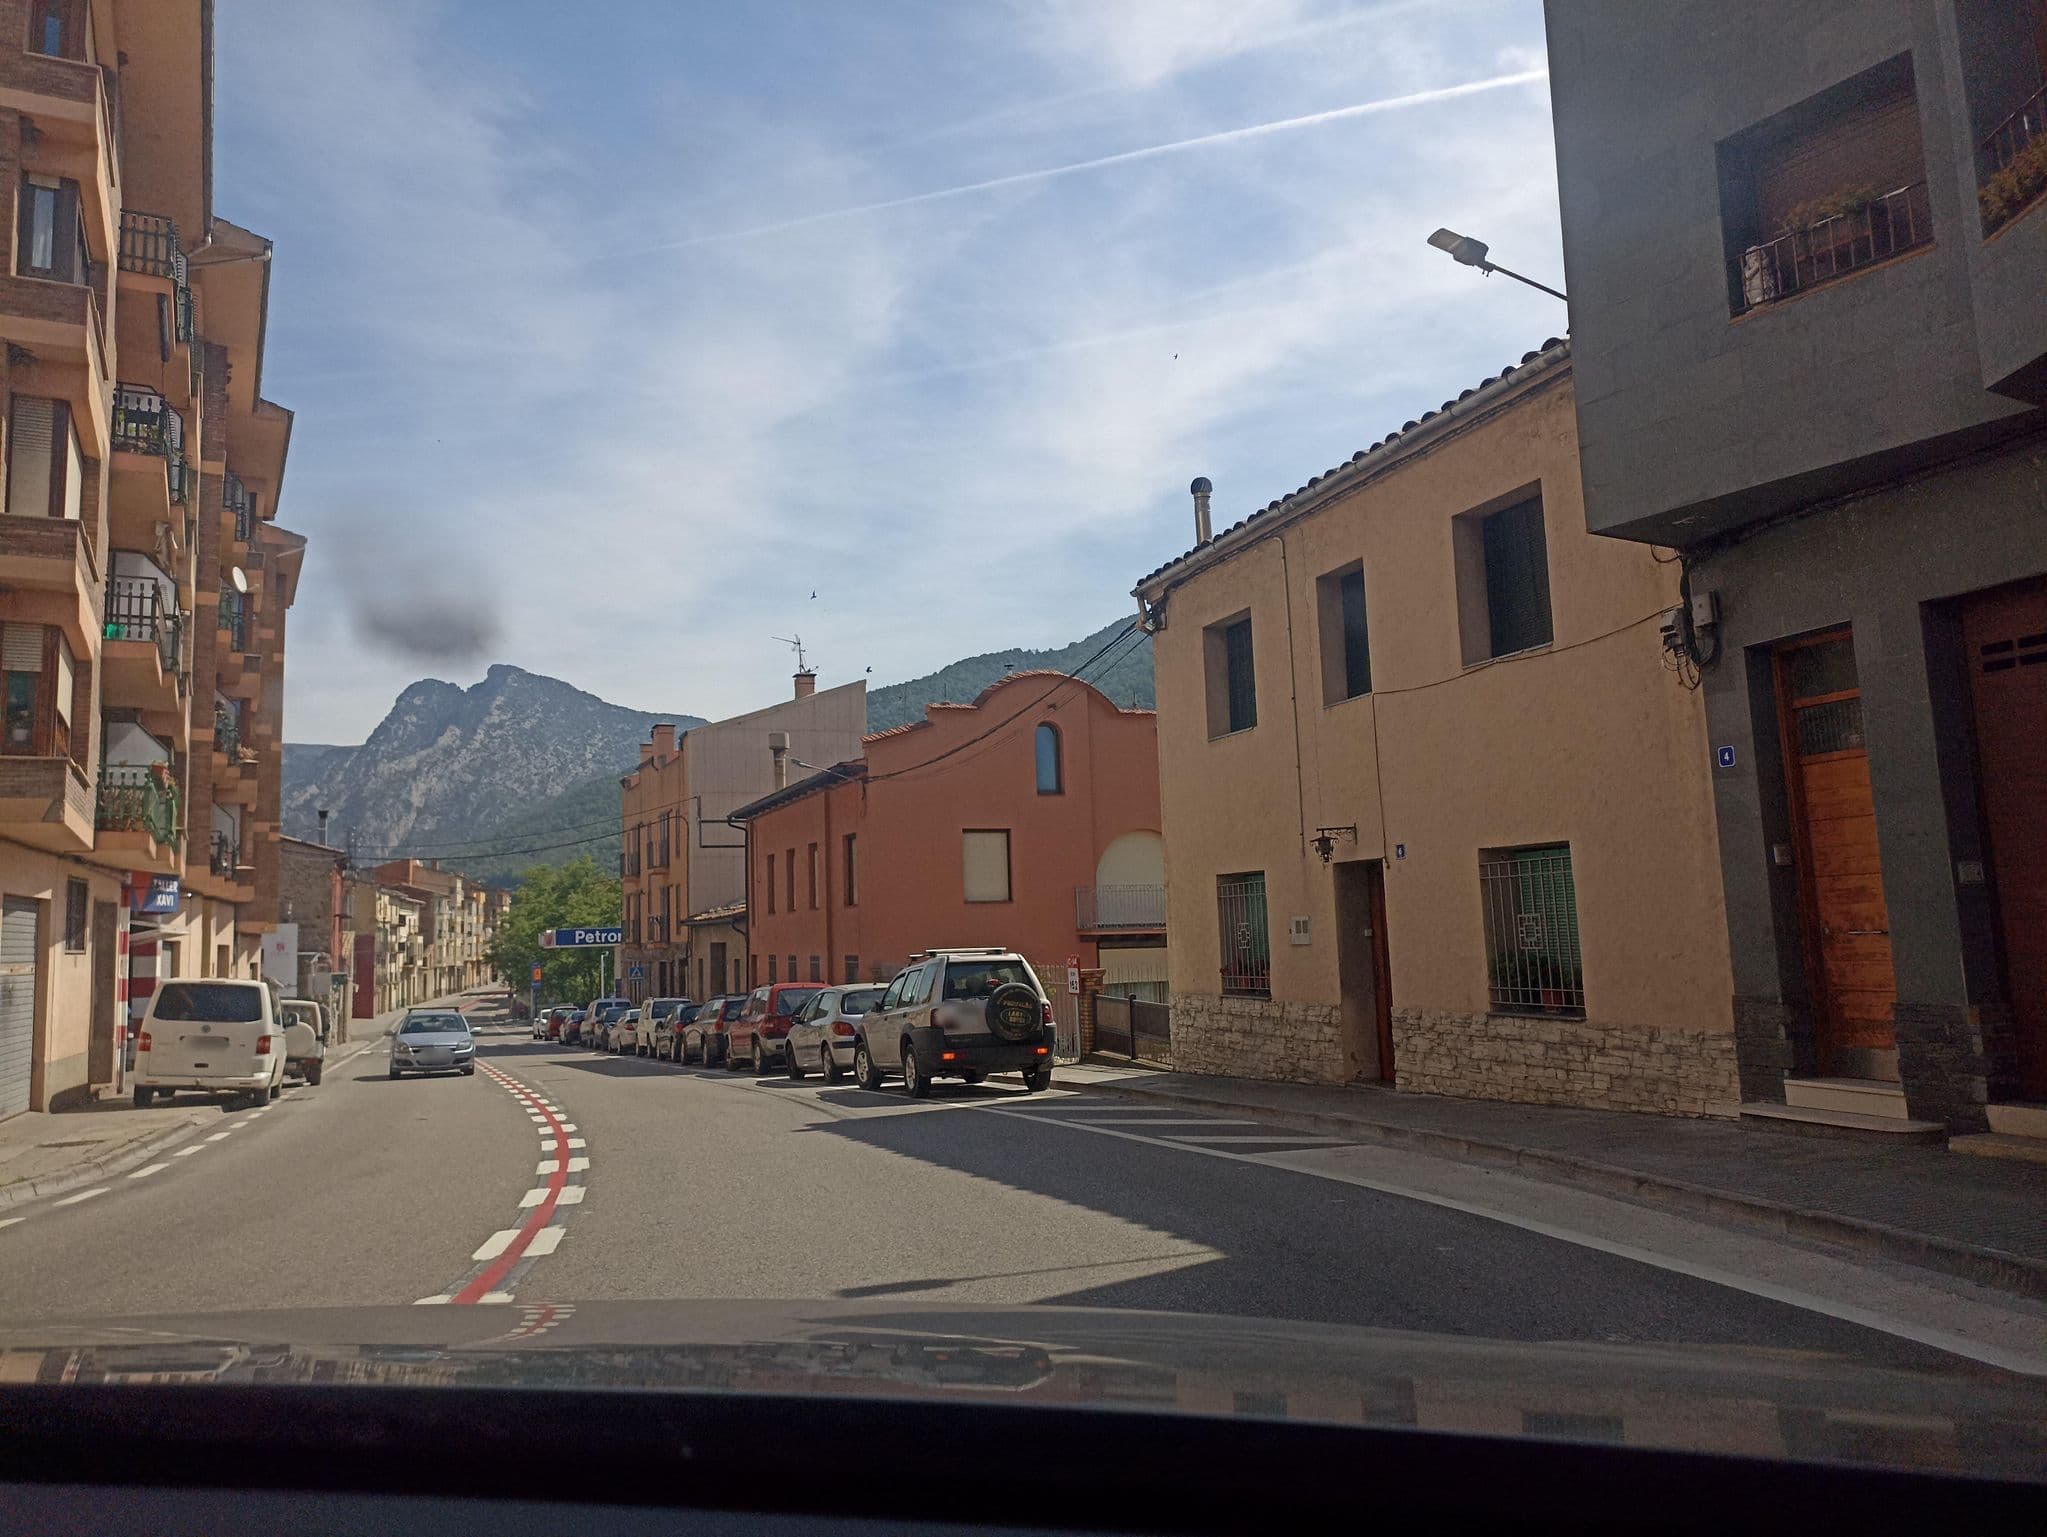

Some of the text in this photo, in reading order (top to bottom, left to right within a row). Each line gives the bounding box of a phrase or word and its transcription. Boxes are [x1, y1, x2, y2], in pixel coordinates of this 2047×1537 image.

[1723, 752, 1730, 762] 4
[152, 879, 178, 893] TALLER
[156, 894, 174, 907] XAVI
